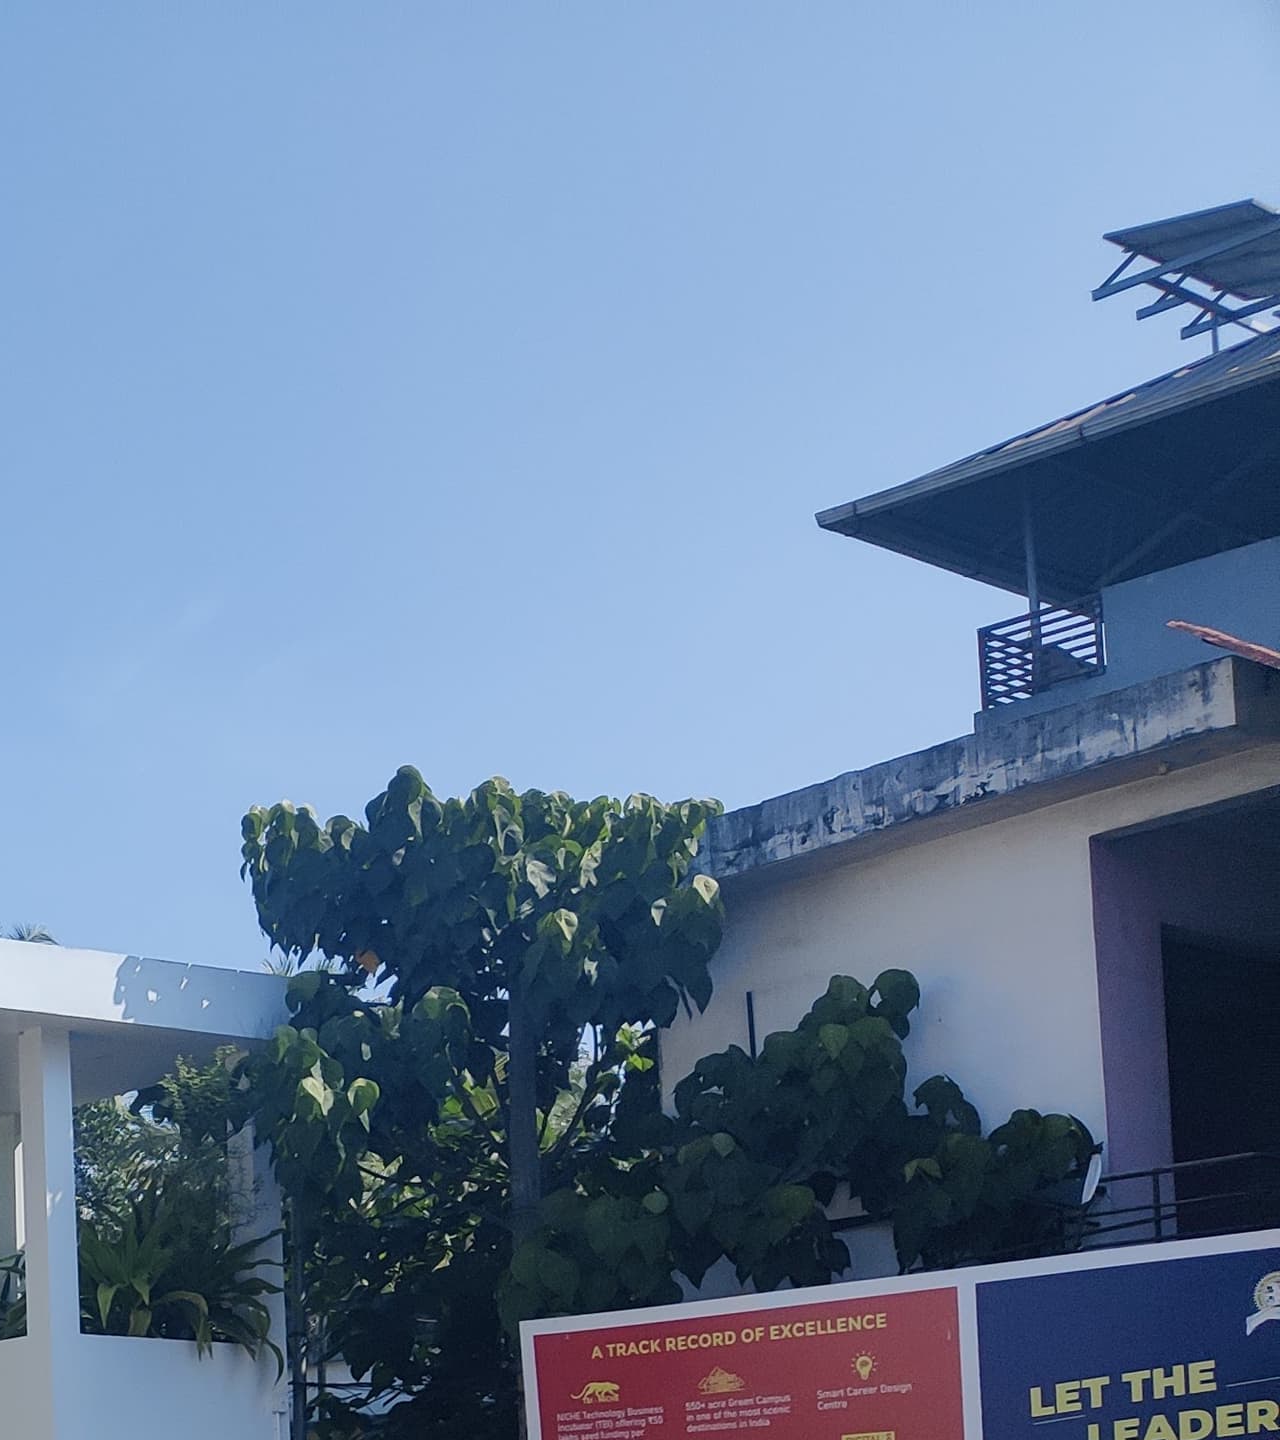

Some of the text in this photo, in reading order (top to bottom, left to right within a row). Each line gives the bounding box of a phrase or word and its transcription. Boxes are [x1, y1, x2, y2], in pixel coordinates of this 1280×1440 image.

[591, 1313, 887, 1360] A TRACK RECORD OF EXCELLENCE
[816, 1383, 913, 1400] Smart Career Design
[1030, 1360, 1217, 1418] LET THE
[817, 1400, 848, 1411] Centre
